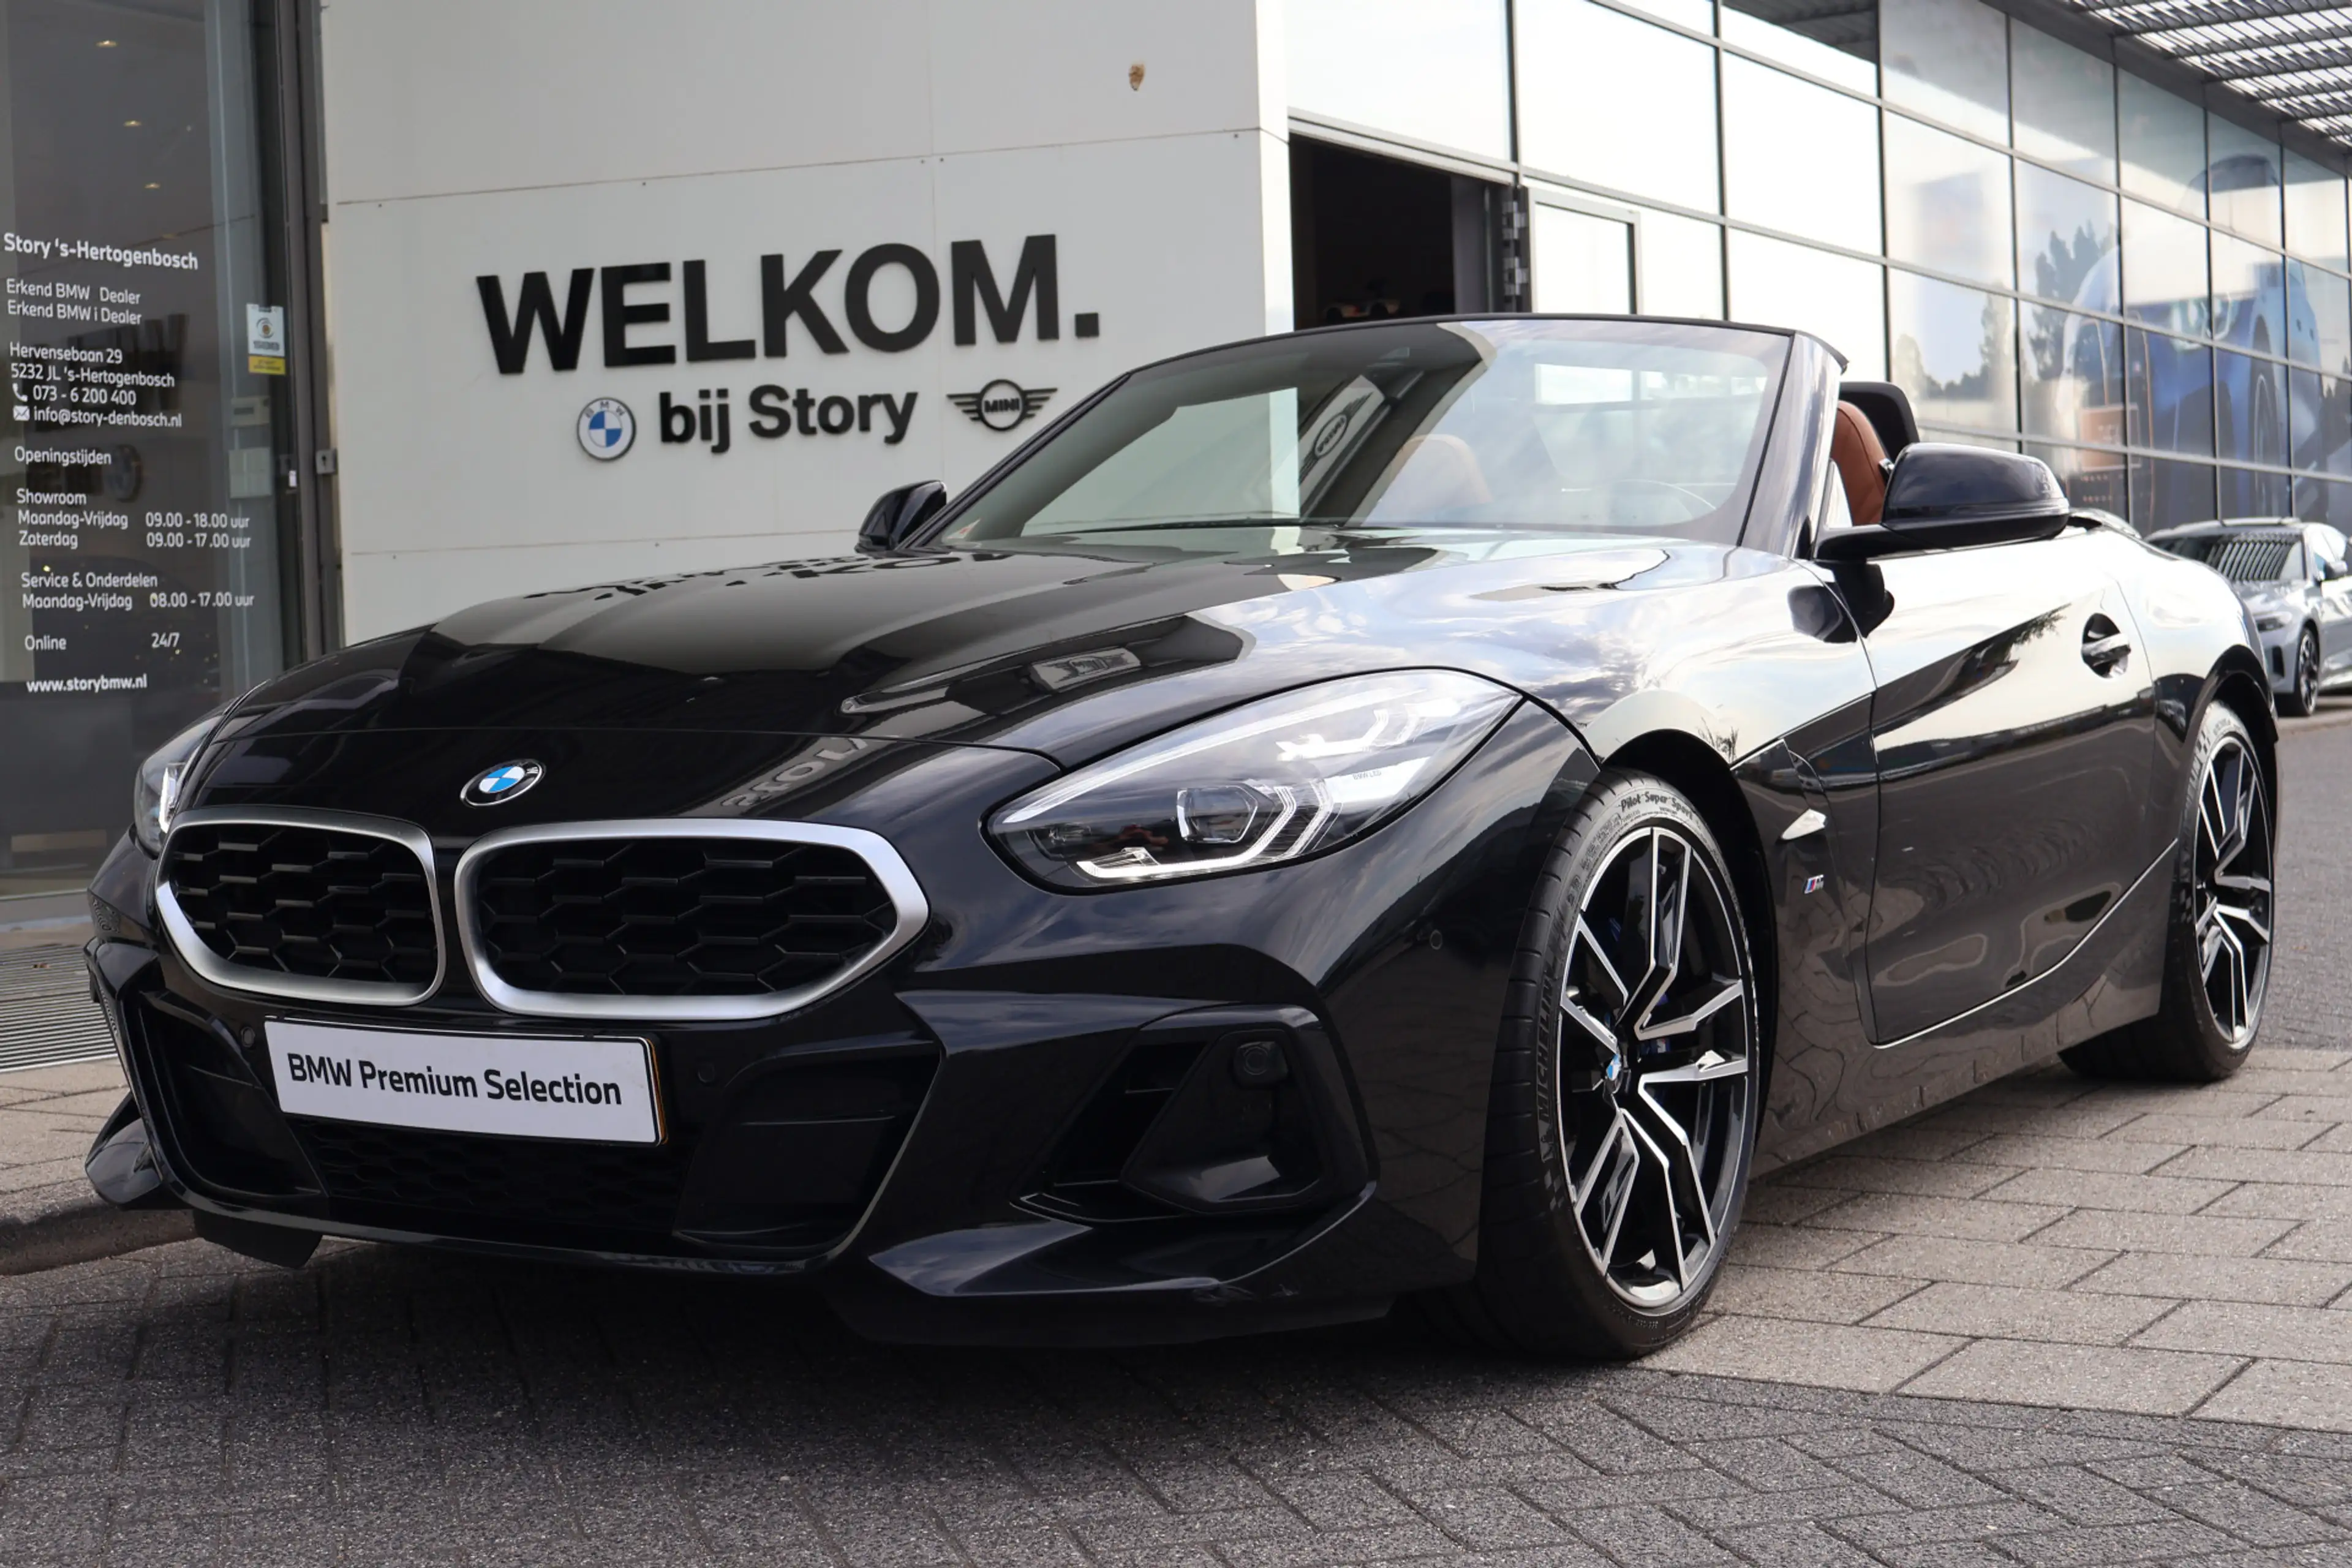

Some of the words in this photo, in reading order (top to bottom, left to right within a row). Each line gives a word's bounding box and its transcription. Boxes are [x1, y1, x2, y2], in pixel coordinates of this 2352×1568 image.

[4, 233, 51, 259] Story
[55, 238, 198, 270] 's-Hertogenbosch
[7, 278, 52, 297] Erkend
[56, 283, 90, 300] BMW
[100, 287, 140, 304] Dealer
[8, 299, 53, 318] Erkend
[57, 304, 91, 320] BMW
[94, 306, 97, 321] i
[101, 307, 141, 324] Dealer
[477, 234, 1099, 375] WELKOM.
[10, 342, 104, 363] Hervensebaan
[106, 348, 123, 364] 29
[11, 363, 43, 380] 5232
[47, 365, 61, 381] JL
[64, 366, 175, 388] 's-Hertogenbosch
[33, 385, 57, 401] 073
[70, 387, 79, 402] 6
[81, 387, 107, 404] 200
[110, 390, 137, 405] 400
[984, 398, 1020, 413] MINI
[34, 405, 181, 427] info@story-denbosch.nl
[660, 389, 729, 454] bij
[749, 385, 918, 445] Story
[15, 446, 111, 467] Openingstijden
[17, 488, 86, 505] Showroom
[18, 510, 128, 530] Maandag-Vrijdag
[146, 512, 183, 527] 09.00
[194, 513, 227, 528] 18.00
[231, 518, 249, 528] uur
[19, 530, 78, 549] Zaterdag
[146, 532, 184, 547] 09.00
[232, 537, 251, 548] uur
[21, 572, 69, 588] Service
[72, 572, 83, 587] &
[86, 572, 157, 587] Onderdelen
[23, 593, 132, 612] Maandag-Vrijdag
[149, 592, 187, 608] 08.00
[235, 596, 254, 606] uur
[25, 635, 66, 650] Online
[152, 632, 179, 648] 24/7
[26, 673, 147, 693] www.storybmw.nl
[1621, 794, 1641, 812] Pilot
[1672, 797, 1692, 820] Sport
[288, 1054, 351, 1087] BMW
[359, 1060, 478, 1098] Premium
[484, 1069, 621, 1104] Selection
